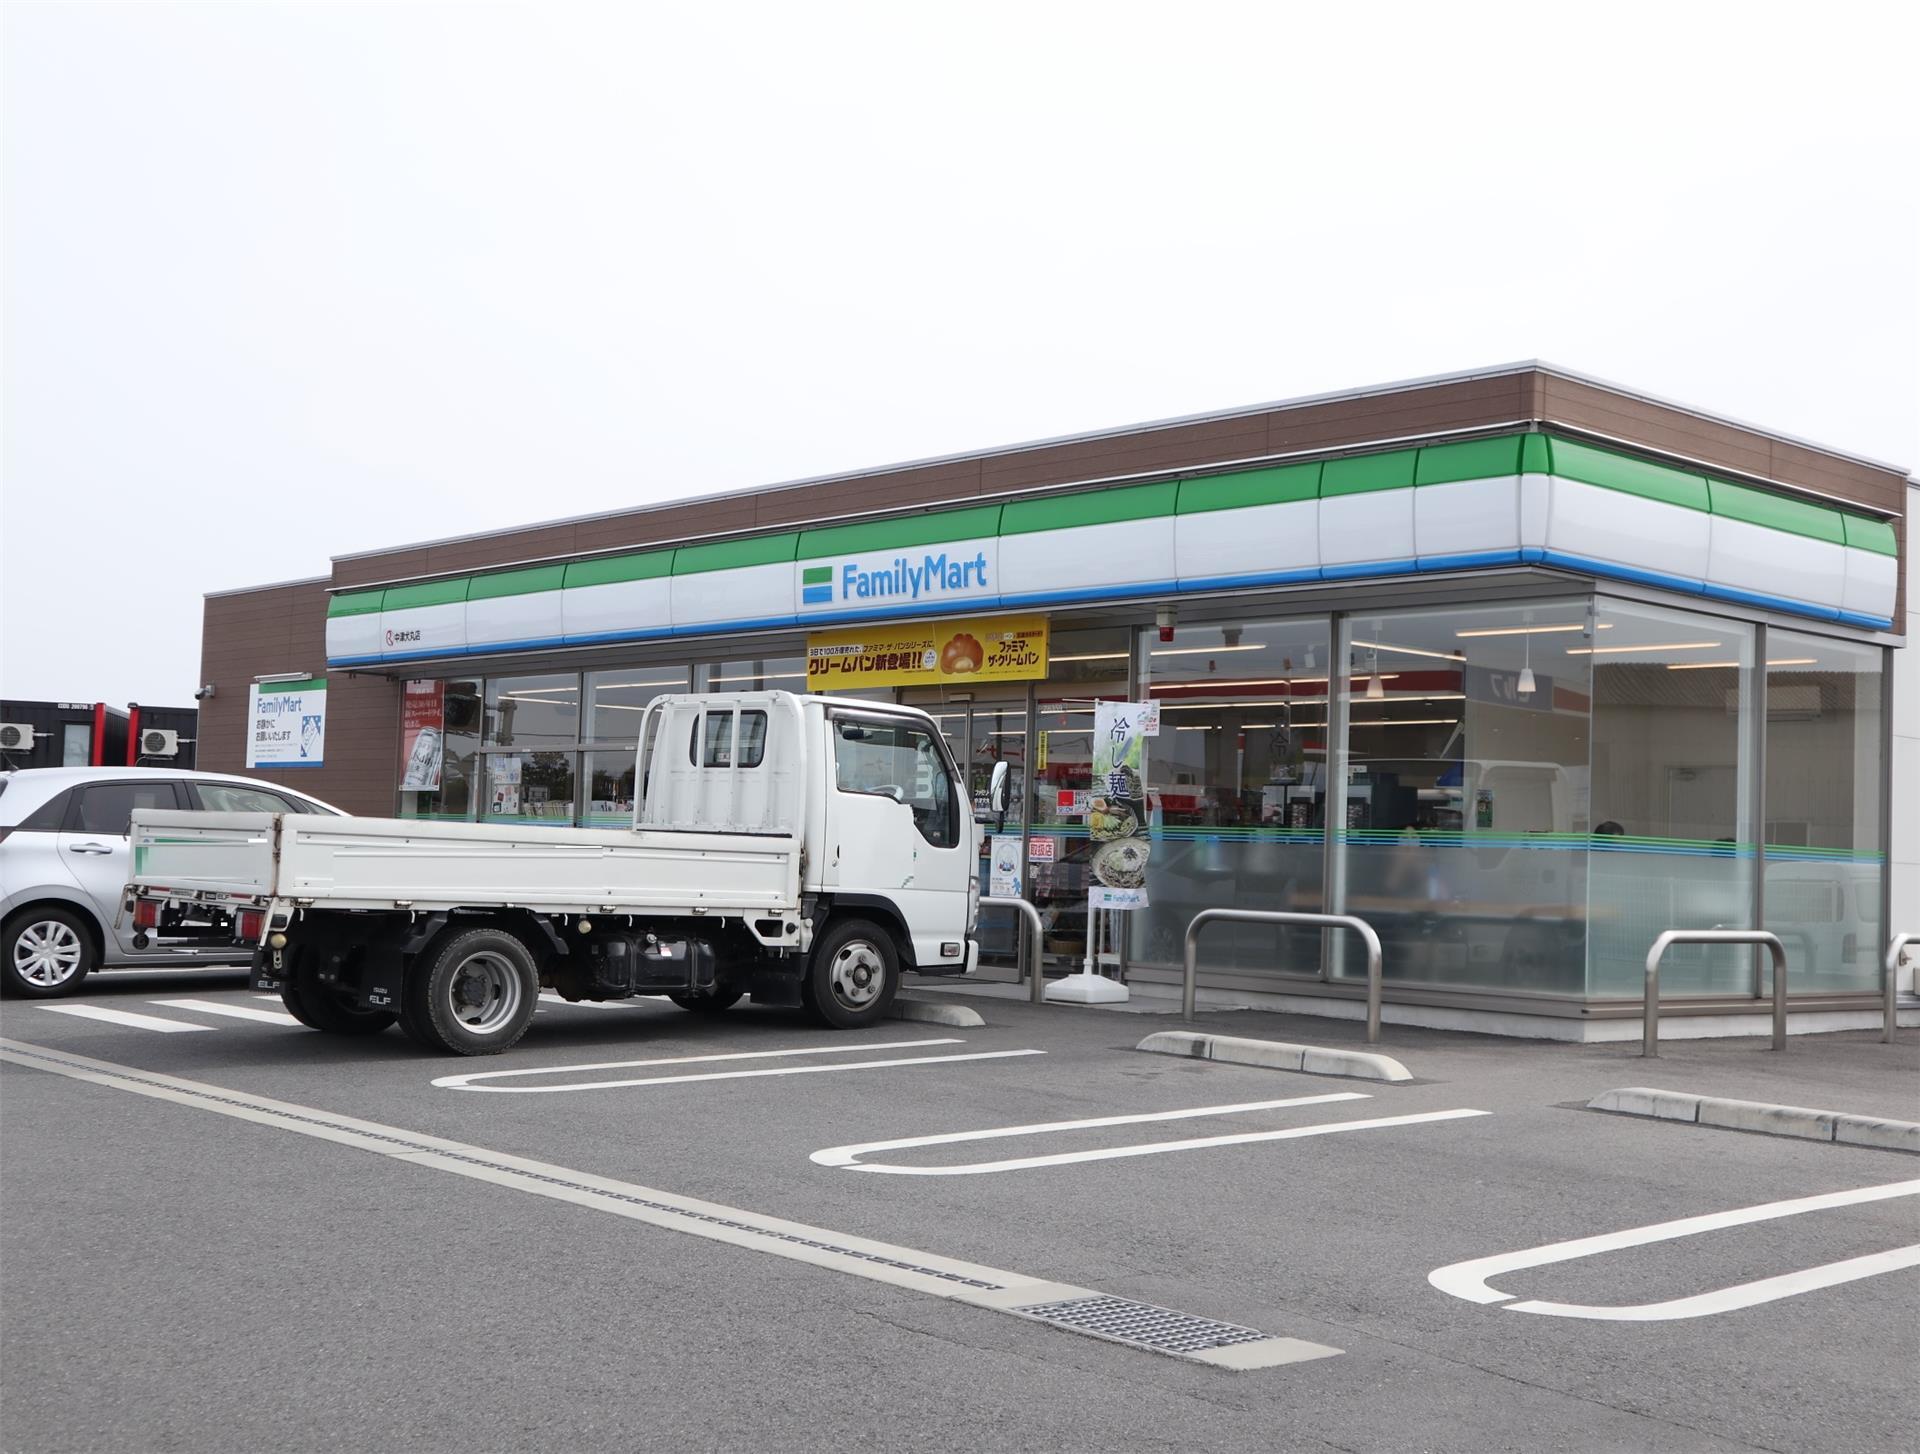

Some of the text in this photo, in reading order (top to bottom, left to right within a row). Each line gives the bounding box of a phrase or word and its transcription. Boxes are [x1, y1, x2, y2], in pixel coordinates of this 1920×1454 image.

[842, 552, 987, 600] FamilyMart
[257, 696, 302, 717] FamilyMart
[1108, 716, 1131, 799] 冷し麺
[1030, 843, 1053, 857] 取扱店
[257, 980, 281, 989] ELF
[369, 995, 392, 1006] ELF
